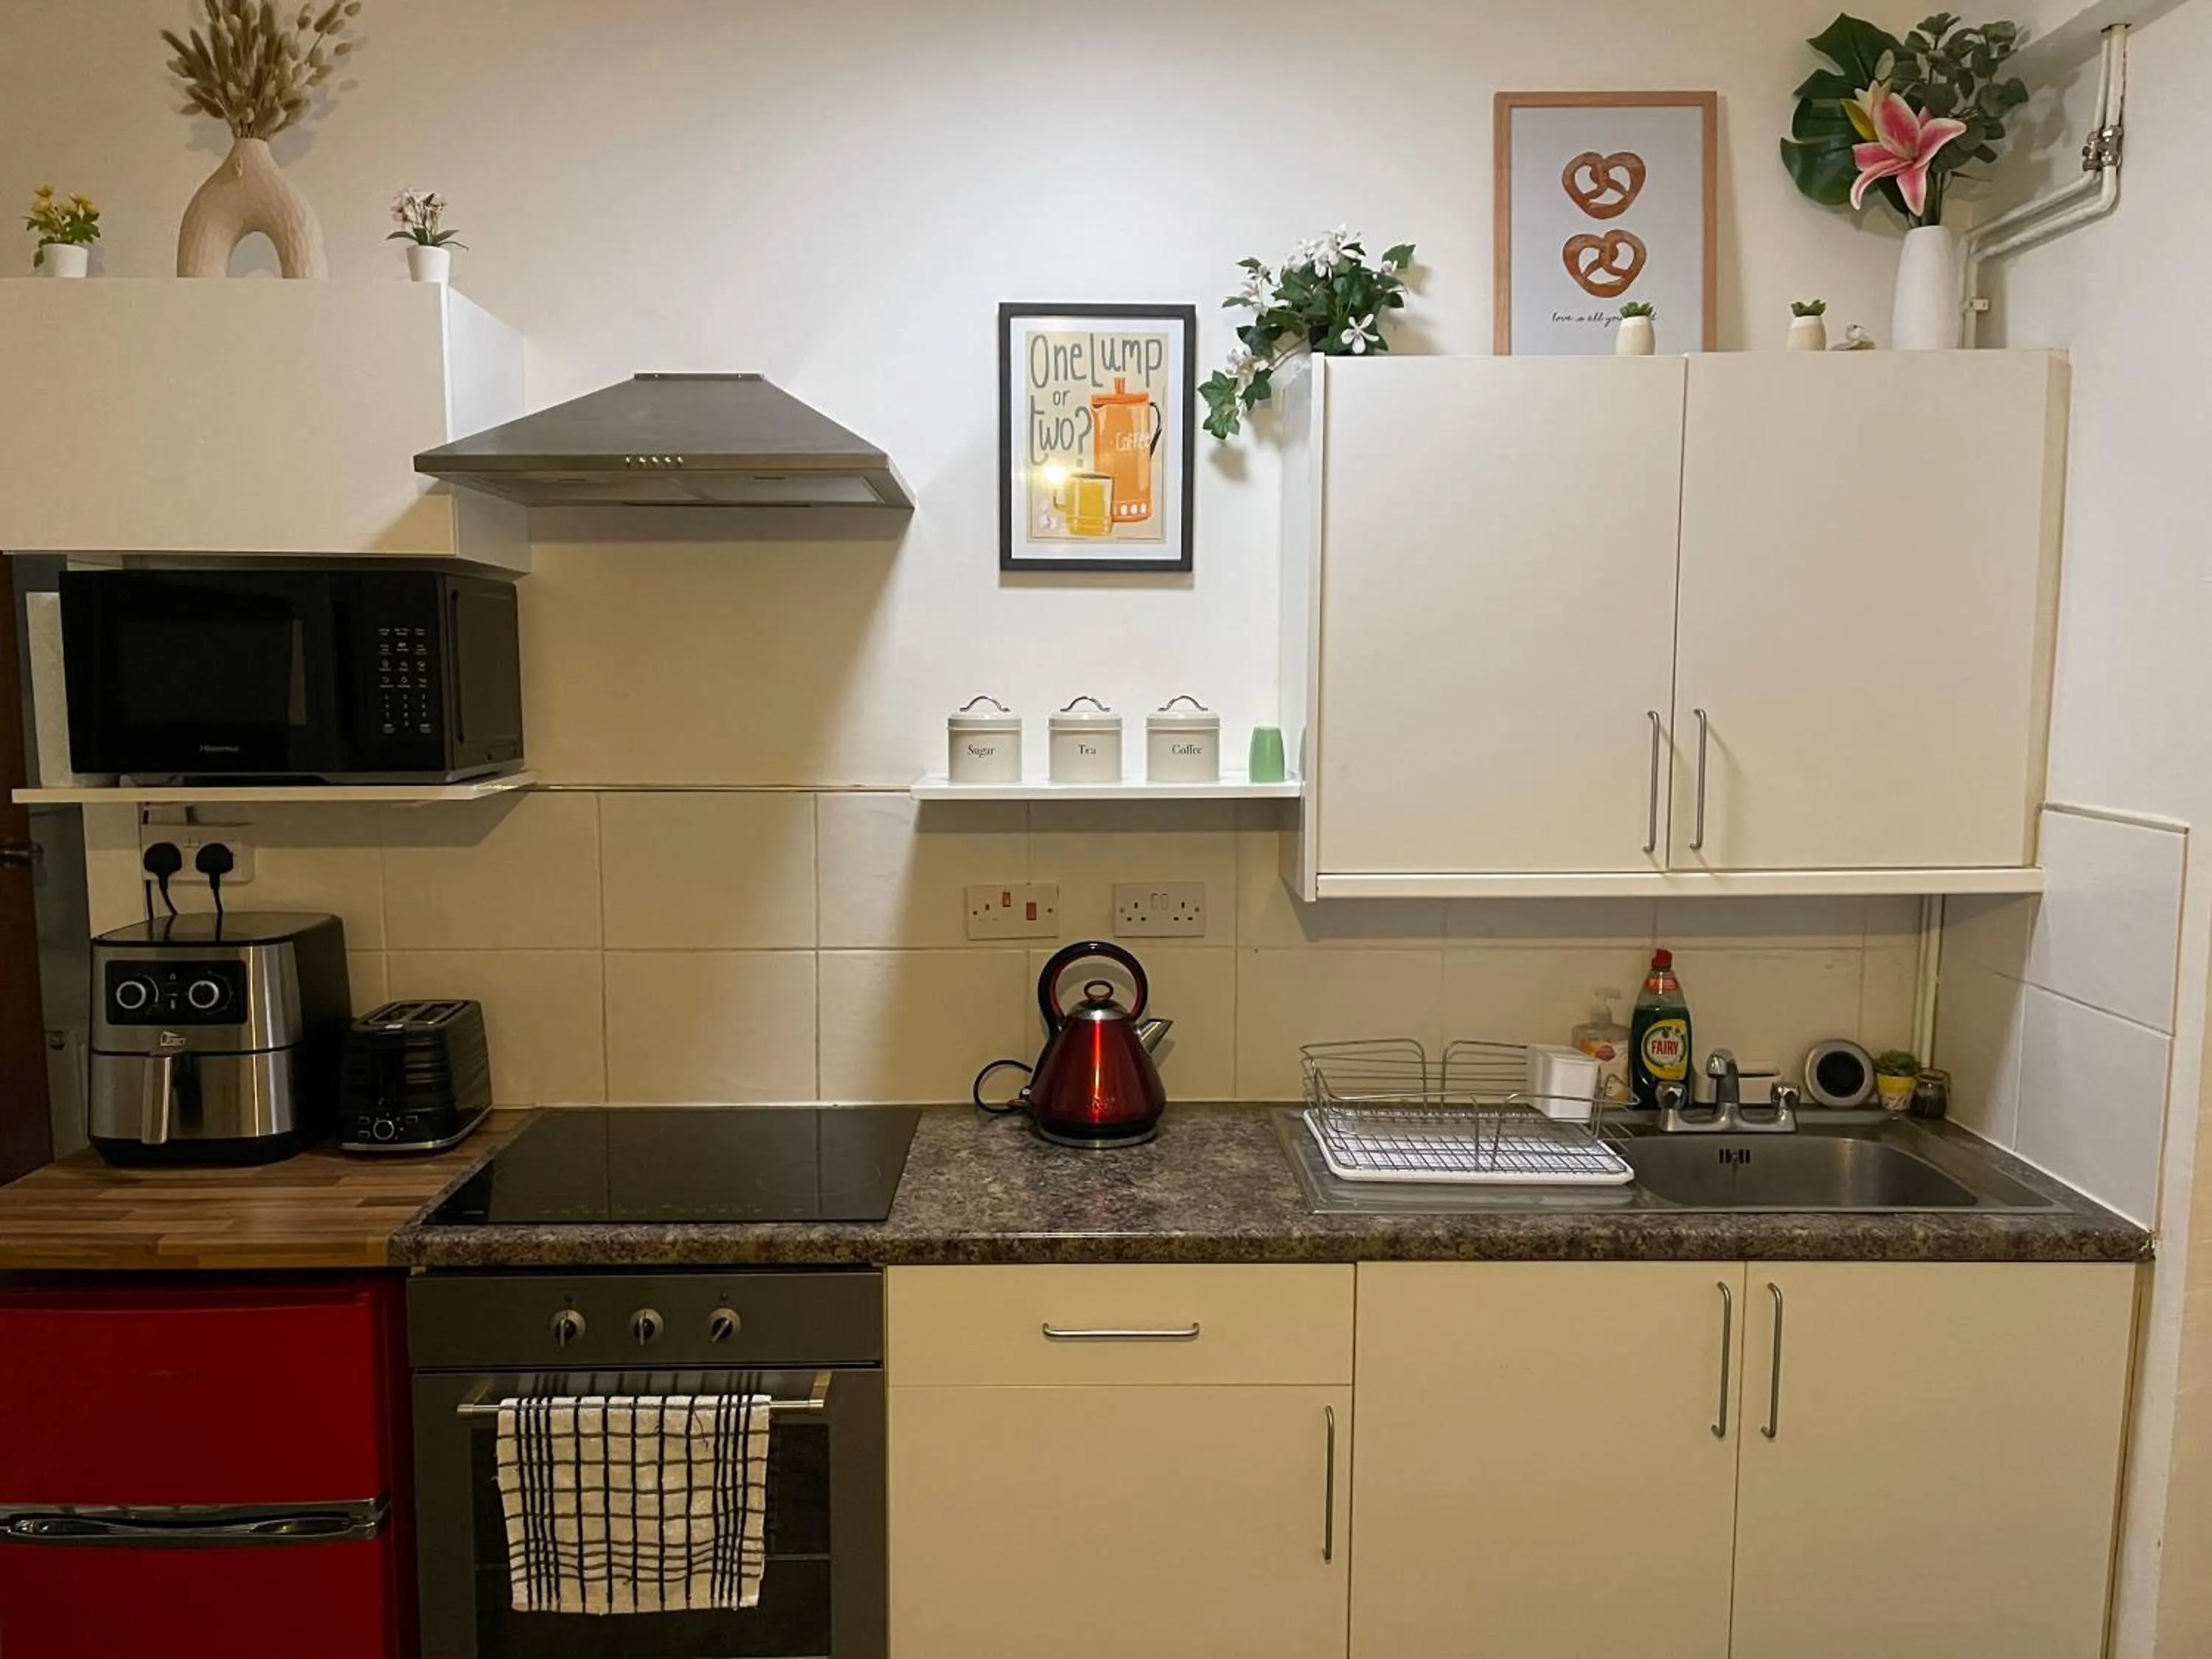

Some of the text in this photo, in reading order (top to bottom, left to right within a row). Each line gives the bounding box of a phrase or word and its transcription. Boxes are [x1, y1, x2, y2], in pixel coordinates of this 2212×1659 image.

[1551, 312, 1572, 322] love
[1031, 333, 1162, 388] One Lump
[1053, 390, 1071, 406] or
[1031, 394, 1092, 468] two?
[967, 744, 995, 757] Sugar
[1078, 745, 1096, 755] Tea
[1172, 744, 1203, 755] Coffee
[1652, 1040, 1678, 1055] FAIRY
